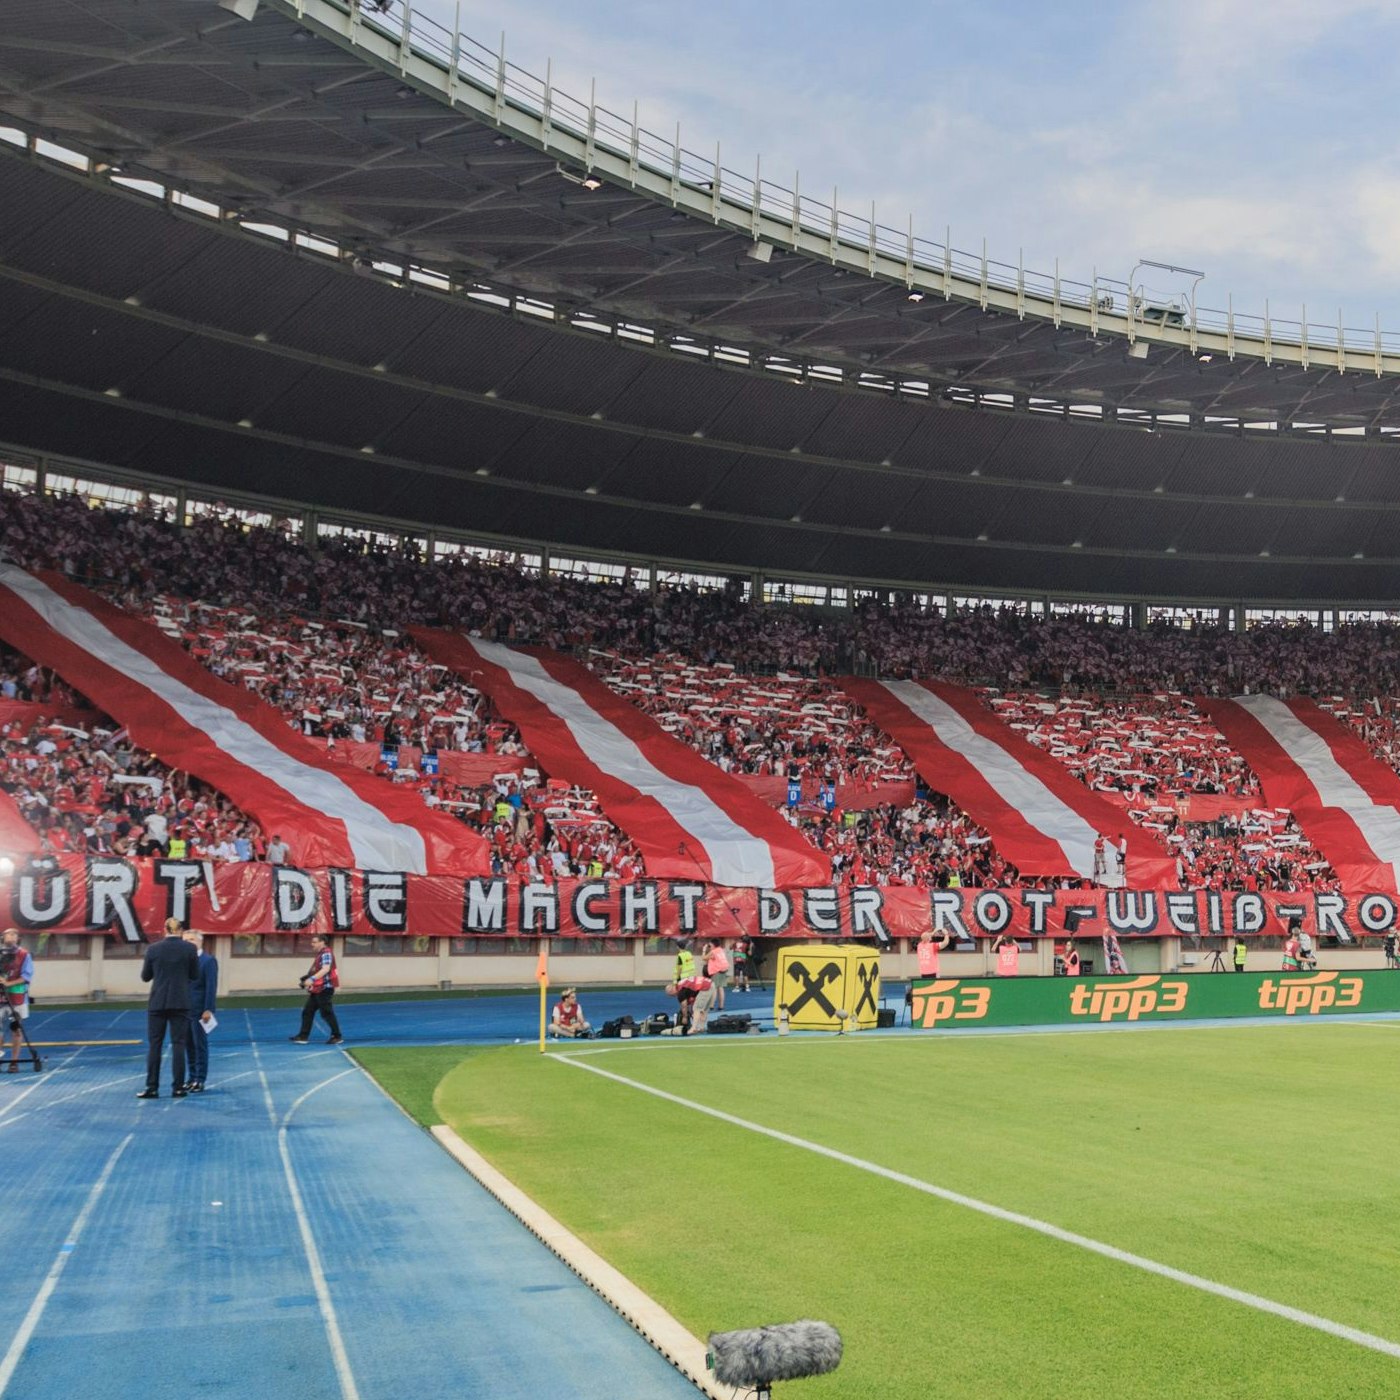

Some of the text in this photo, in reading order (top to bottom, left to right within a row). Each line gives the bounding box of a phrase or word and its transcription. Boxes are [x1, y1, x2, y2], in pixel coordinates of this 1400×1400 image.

[274, 868, 406, 930] DIE
[463, 875, 704, 934] MACHT
[757, 888, 891, 947] DER
[1070, 976, 1188, 1021] tipp3
[1258, 971, 1364, 1014] tipp3
